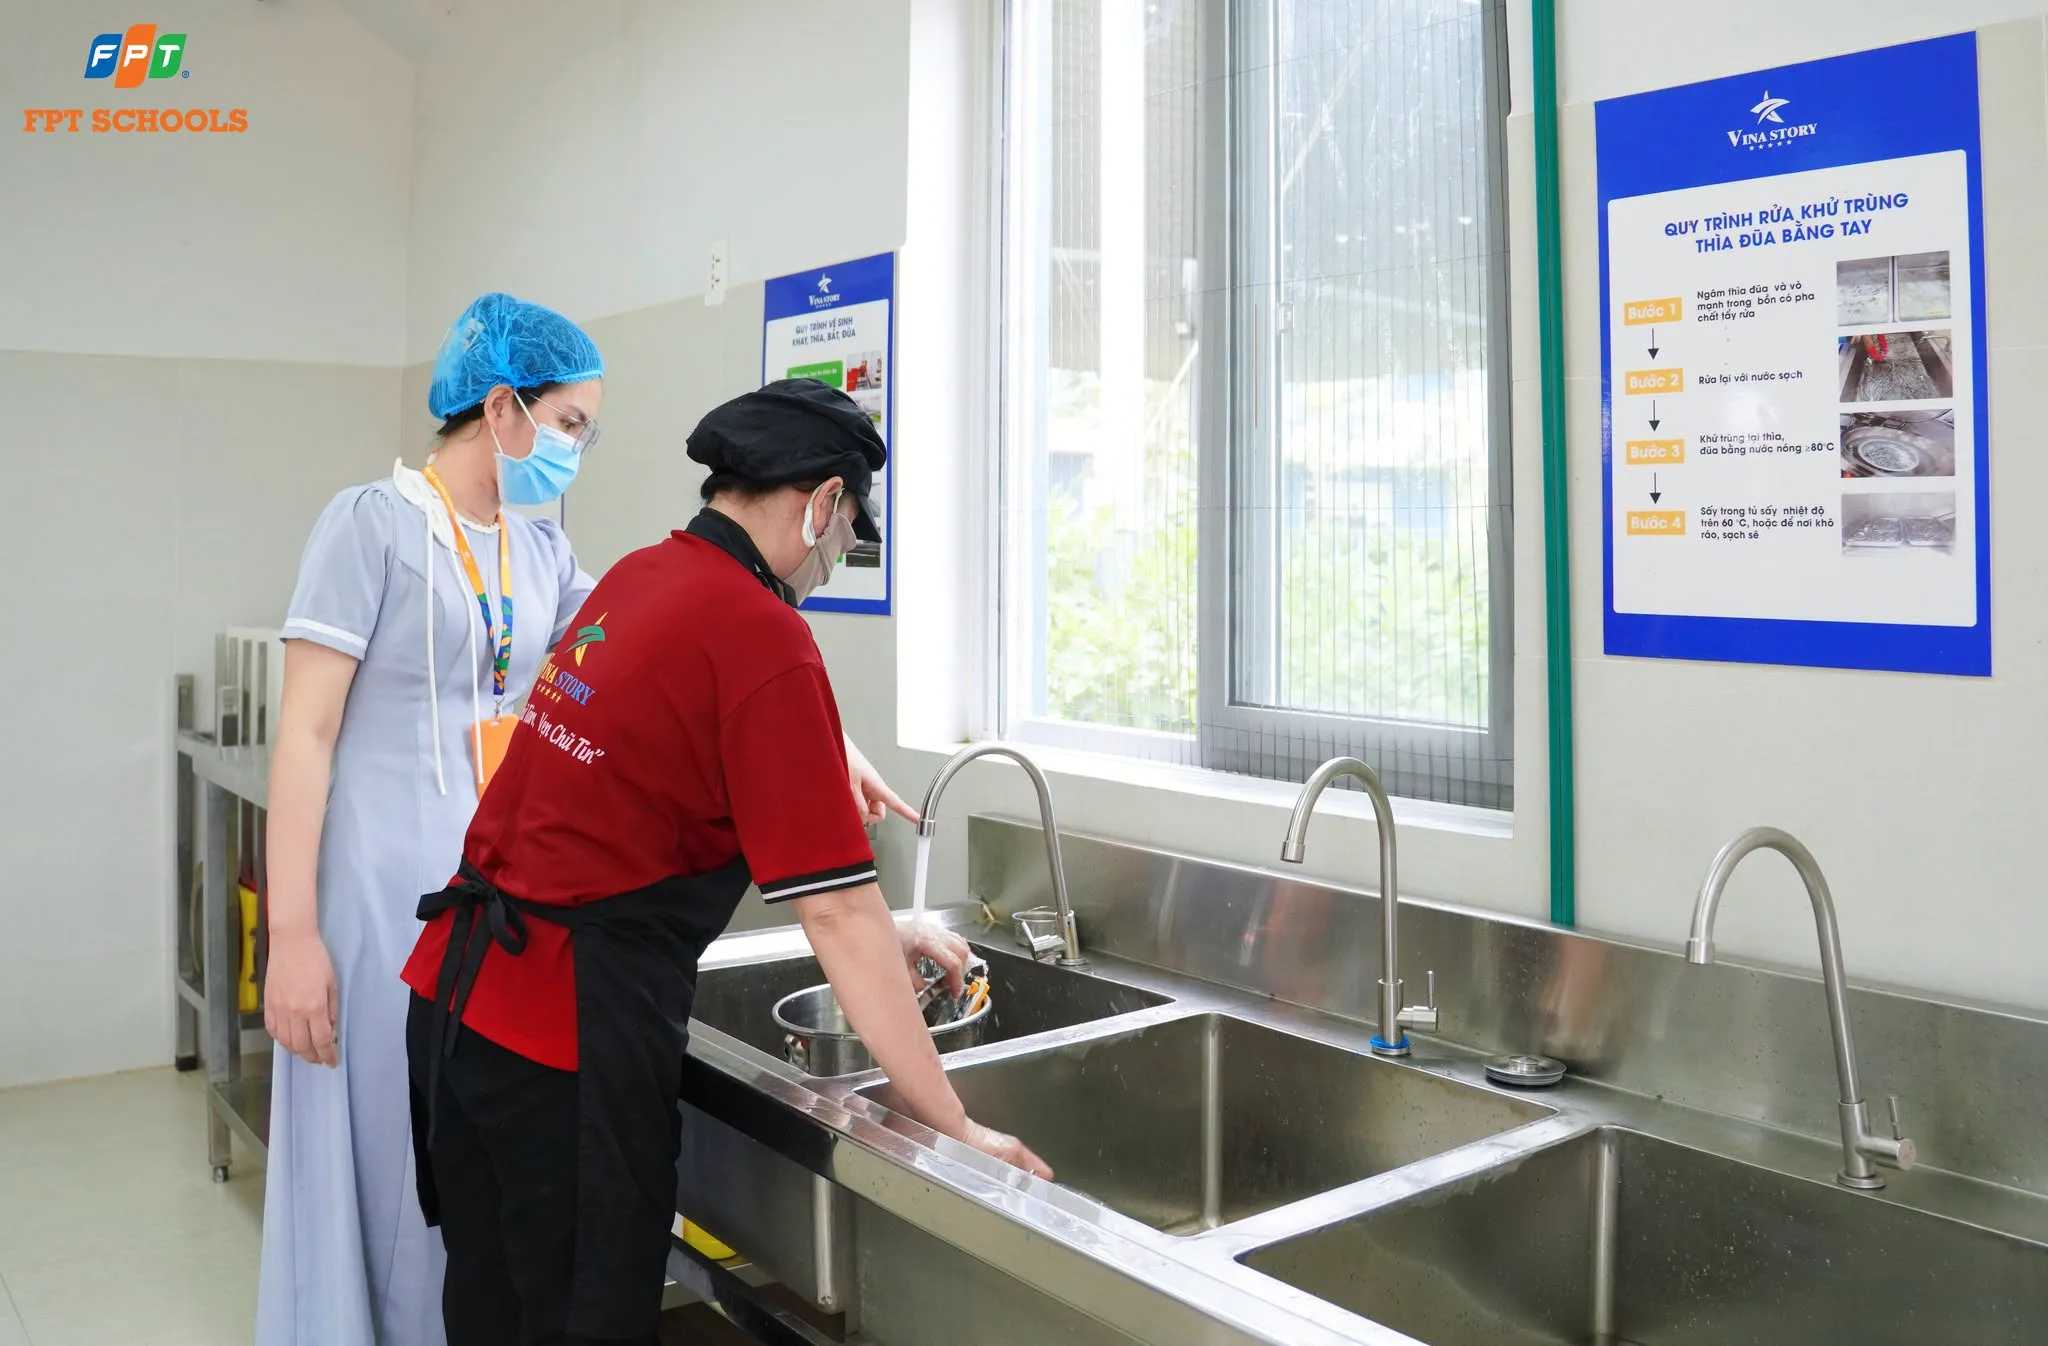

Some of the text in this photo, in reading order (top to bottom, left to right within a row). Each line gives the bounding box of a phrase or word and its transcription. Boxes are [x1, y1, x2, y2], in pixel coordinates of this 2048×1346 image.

[1727, 122, 1818, 147] VINA STORY
[1664, 192, 1909, 237] QUY TRÌNH RỬA KHỬ TRÙNG
[1695, 219, 1873, 253] THÌA ĐŨA BẰNG TAY
[1697, 281, 1802, 300] Ngâm thìa đũa và vò
[1697, 293, 1815, 311] mạnh trong bồn có pha
[1628, 303, 1677, 320] Bước 1
[1697, 308, 1755, 322] chất tẩy rửa
[1629, 373, 1680, 389] Bước 2
[1699, 370, 1803, 385] Rửa lại với nước sạch
[1700, 433, 1718, 443] Khử
[1720, 434, 1745, 444] trùng
[1762, 432, 1784, 441] thìa,
[1629, 444, 1680, 459] Bước 3
[1700, 446, 1718, 455] đũa
[1721, 443, 1746, 456] bằng
[1749, 444, 1773, 454] nước
[1776, 444, 1802, 454] nóng
[1701, 505, 1825, 517] Sấy trong tủ sấy nhiệt độ
[1631, 515, 1682, 530] Bước 4
[1701, 518, 1719, 527] trên
[1722, 519, 1733, 527] 60
[1752, 518, 1777, 528] hoặc
[1780, 516, 1793, 527] để
[1797, 518, 1812, 527] nơi
[1815, 518, 1834, 527] khô
[1701, 530, 1759, 541] ráo, sạch sẽ
[554, 670, 596, 706] STORY
[537, 712, 552, 738] Vẹn
[549, 724, 576, 751] Chữ
